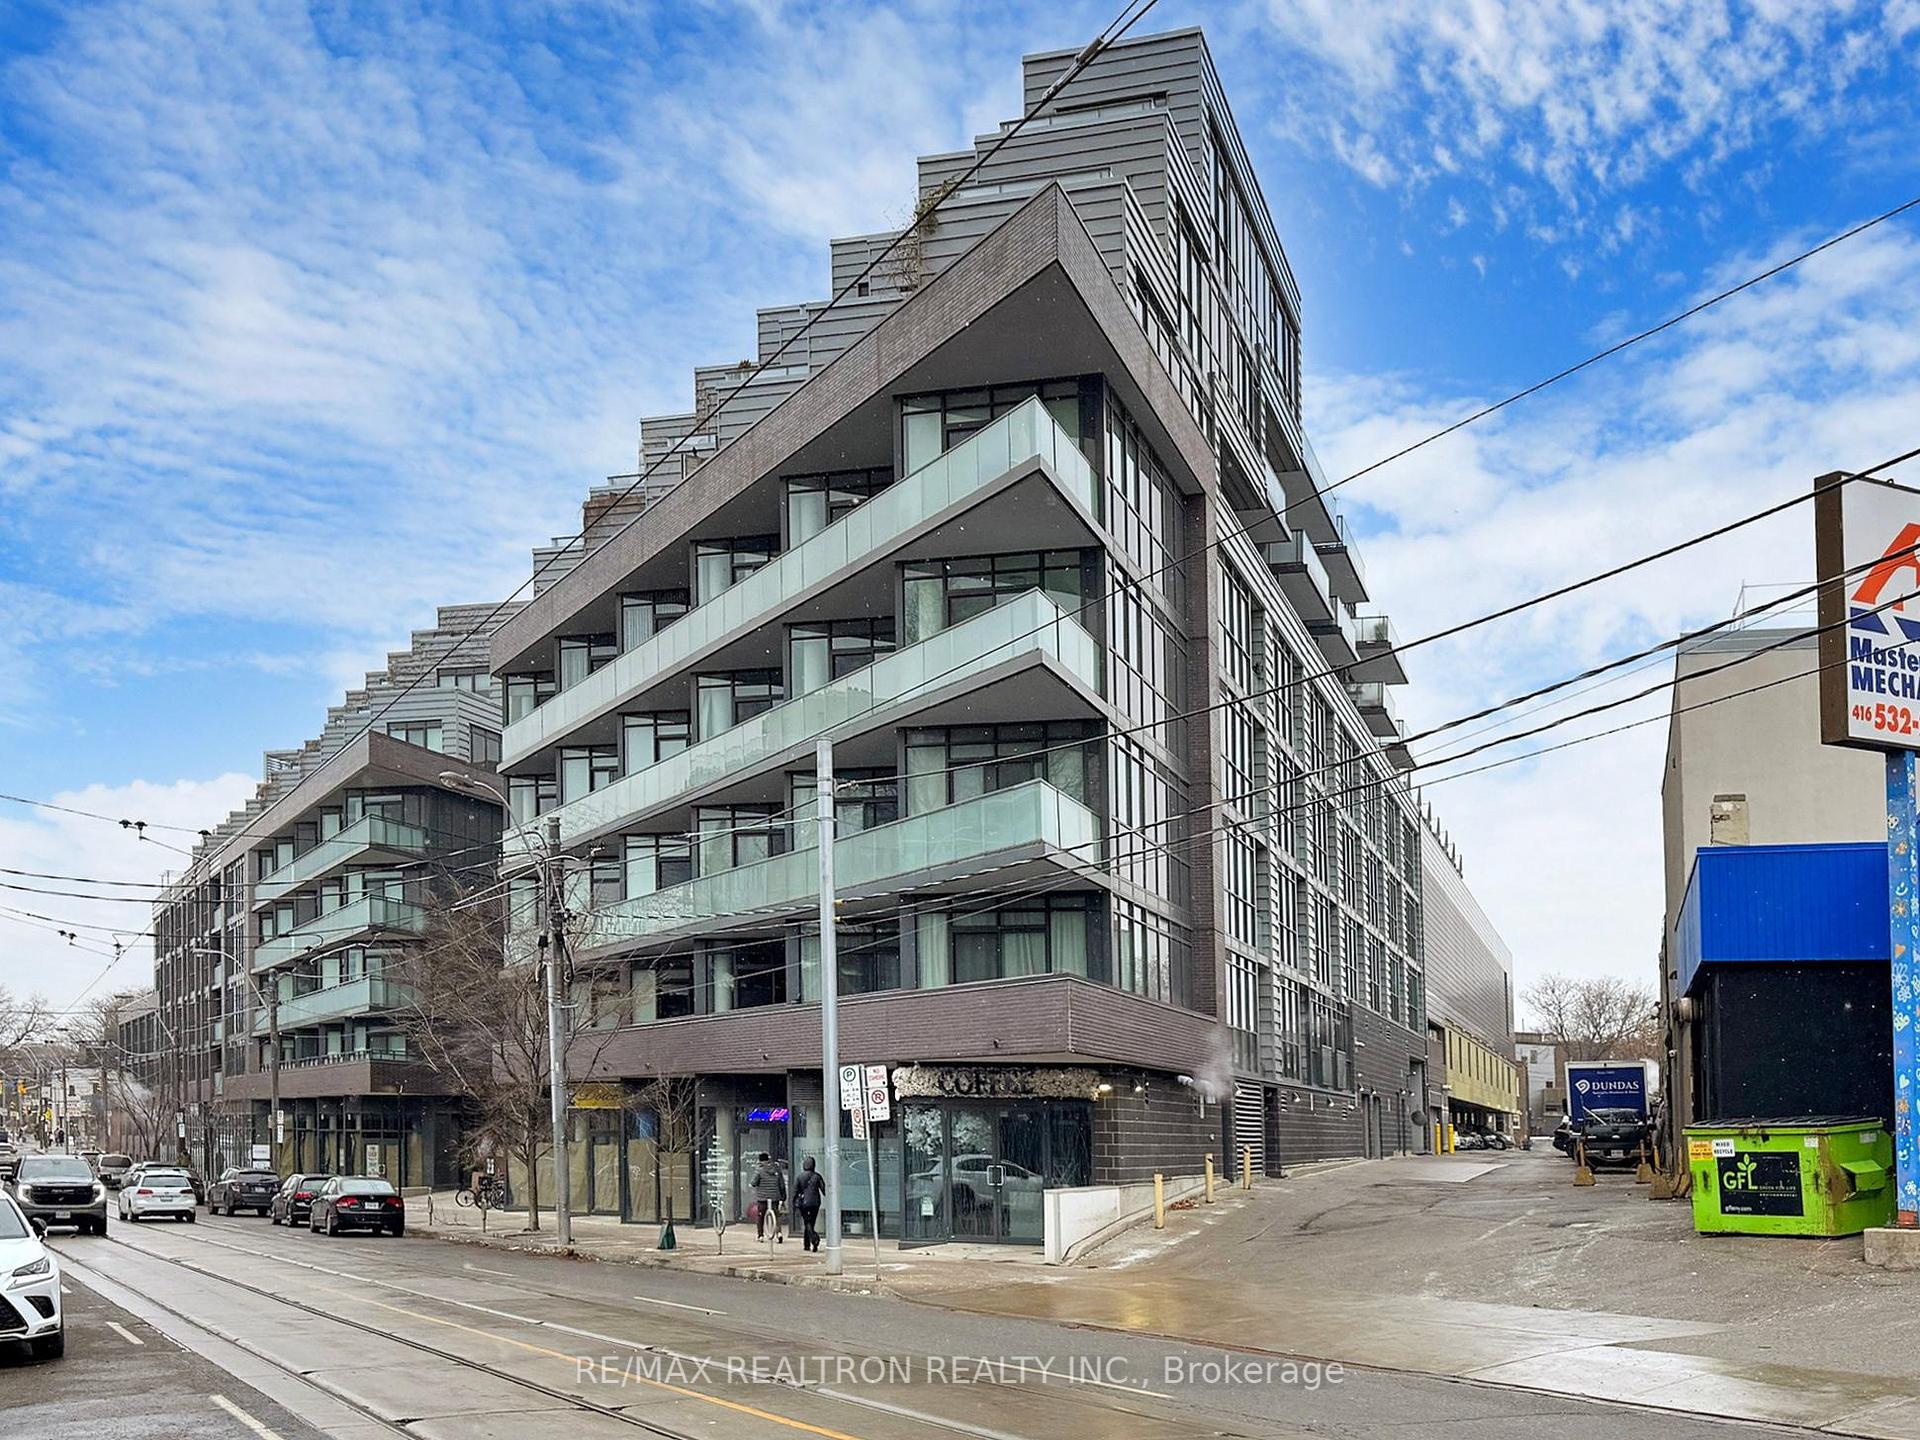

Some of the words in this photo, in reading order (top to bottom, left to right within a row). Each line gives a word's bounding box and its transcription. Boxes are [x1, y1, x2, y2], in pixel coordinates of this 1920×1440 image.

[1850, 636, 1920, 672] Maste
[1852, 705, 1872, 721] 416
[1874, 703, 1920, 734] 532-
[1592, 1081, 1639, 1090] DUNDAS
[1723, 1154, 1758, 1190] GFL
